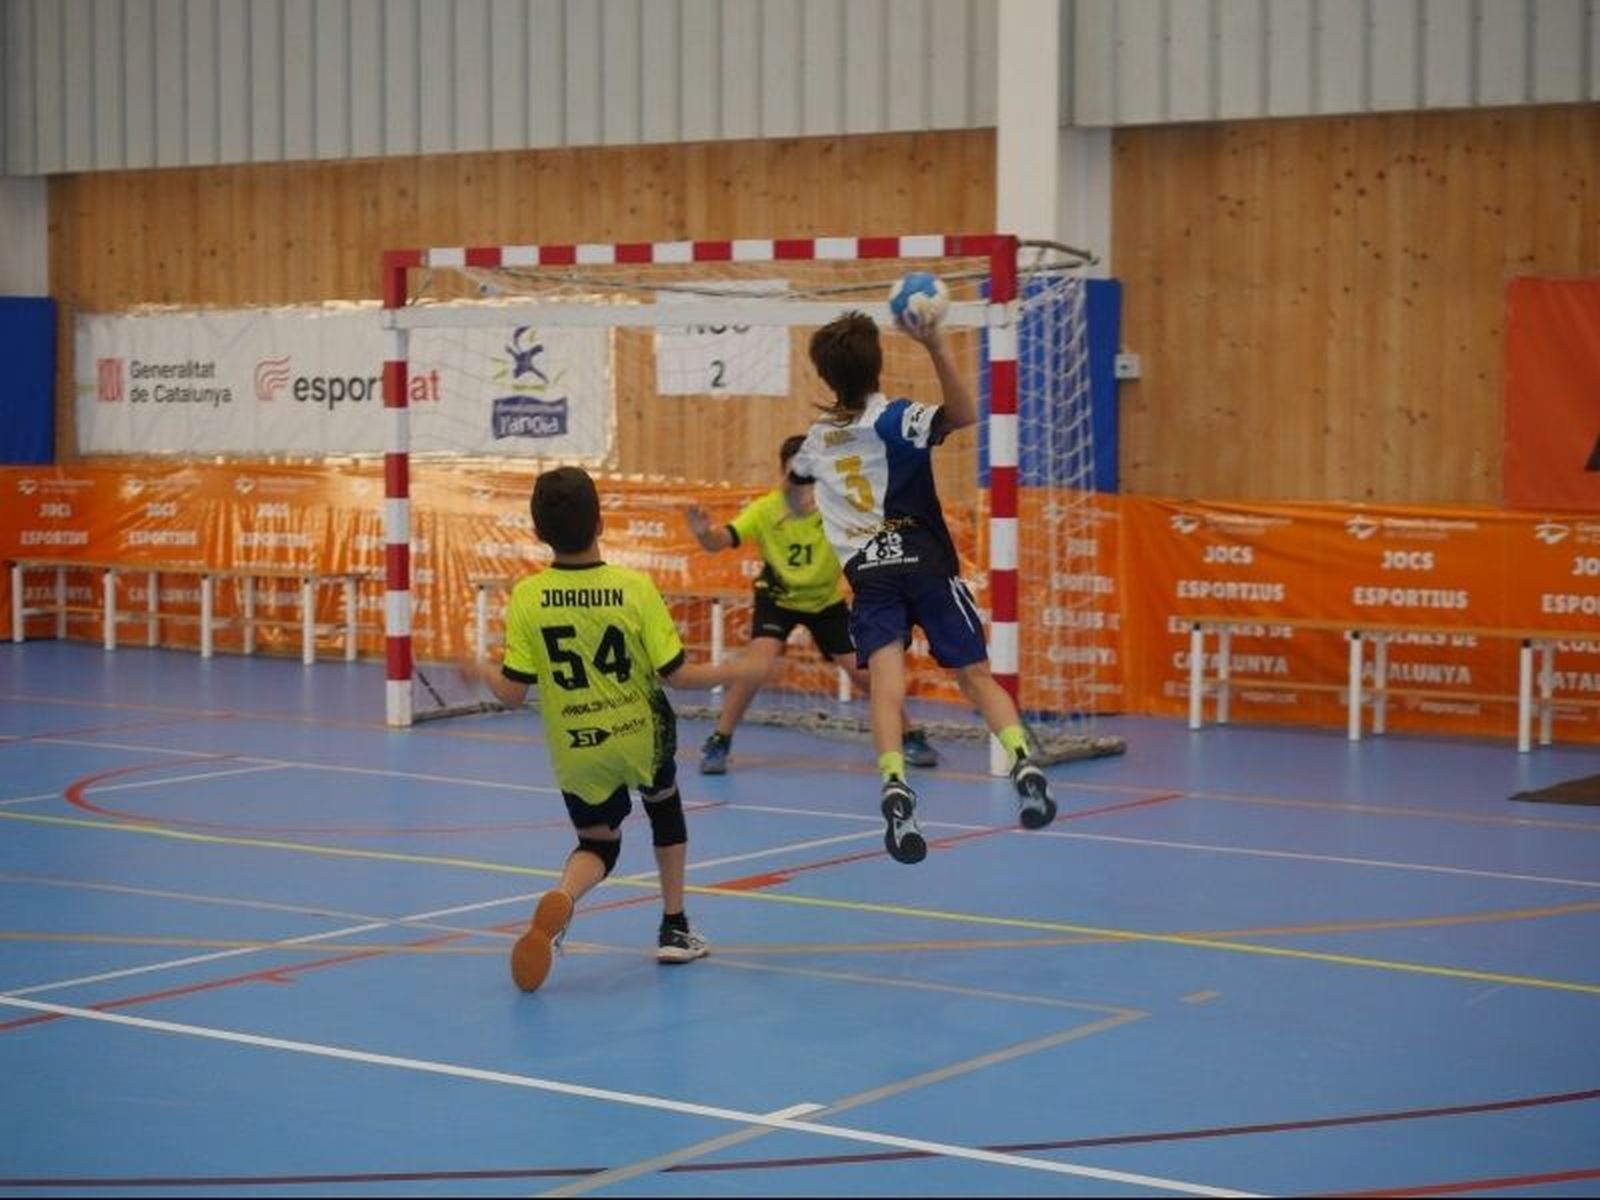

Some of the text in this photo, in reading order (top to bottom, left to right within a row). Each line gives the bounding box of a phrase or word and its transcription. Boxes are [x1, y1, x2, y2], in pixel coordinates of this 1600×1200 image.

[130, 361, 216, 379] Generalitat
[710, 360, 726, 387] 2
[130, 385, 232, 407] de Catalunya
[835, 455, 875, 513] 3
[787, 543, 813, 567] 21
[1202, 545, 1255, 565] JOCS
[1381, 550, 1435, 571] JOCS
[541, 588, 624, 609] JOAQUIN
[1176, 580, 1286, 602] ESPORTIUS
[1352, 586, 1470, 609] ESPORTIUS
[541, 625, 633, 691] 54
[577, 729, 599, 746] ST
